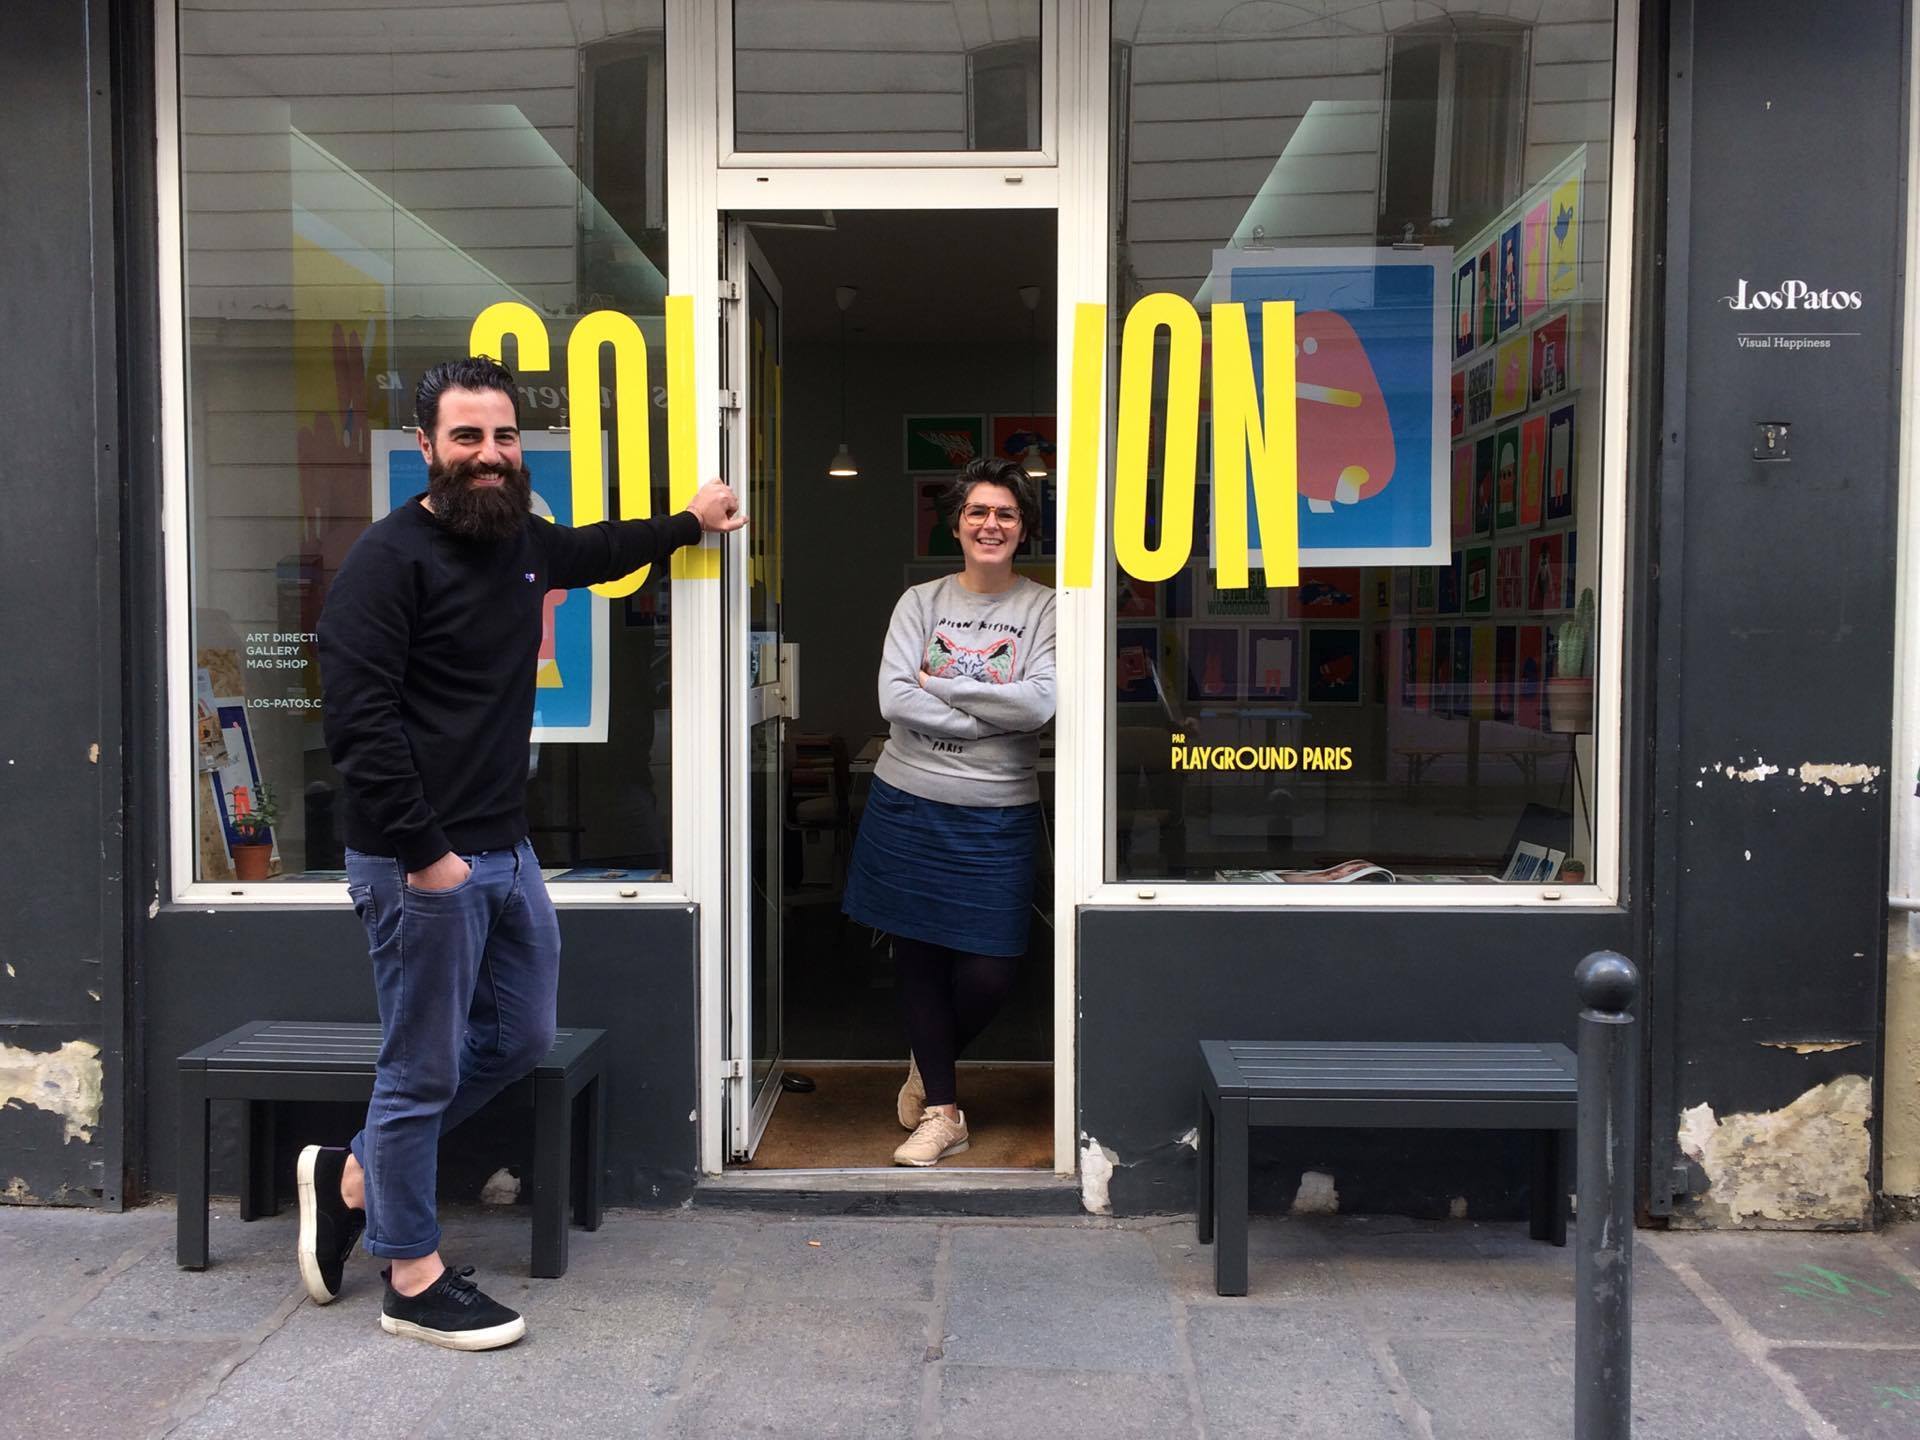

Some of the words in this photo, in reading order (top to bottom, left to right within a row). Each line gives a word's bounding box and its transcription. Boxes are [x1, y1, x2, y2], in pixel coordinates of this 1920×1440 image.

[1737, 336, 1771, 348] Visual
[1774, 336, 1831, 350] Happiness
[246, 633, 270, 642] ART
[246, 646, 300, 656] GALLERY
[246, 659, 273, 669] MAG
[275, 659, 308, 669] SHOP
[1171, 733, 1185, 743] PAR
[931, 741, 964, 754] PARIS
[1171, 746, 1298, 770] PLAYGROUND
[1302, 746, 1353, 770] PARIS
